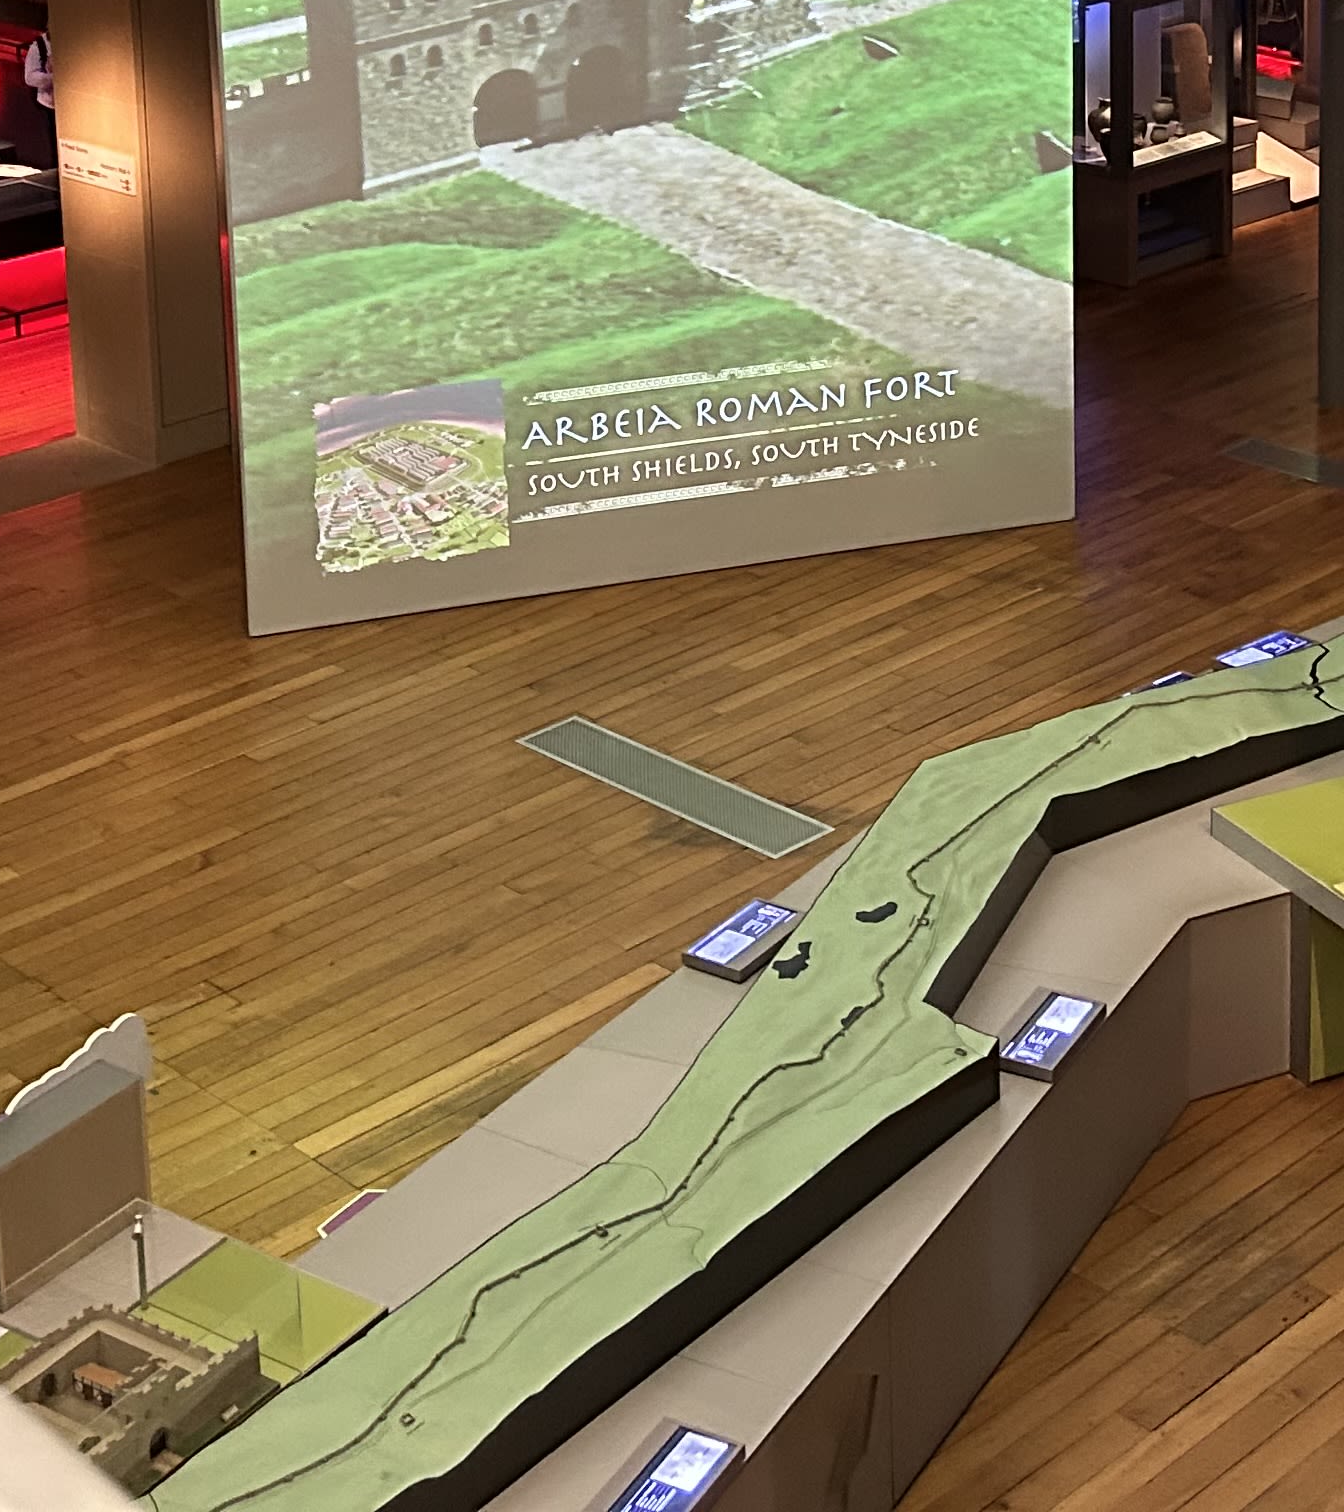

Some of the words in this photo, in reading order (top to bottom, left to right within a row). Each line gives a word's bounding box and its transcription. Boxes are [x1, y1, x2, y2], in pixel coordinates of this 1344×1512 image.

[521, 404, 682, 450] ARBEIA
[696, 383, 846, 427] ROMAN
[864, 369, 960, 409] FORT
[528, 465, 620, 496] SOUTH
[631, 448, 742, 482] SHIELDS,
[751, 436, 839, 466] SOUTH
[847, 417, 980, 451] TYNESIDE
